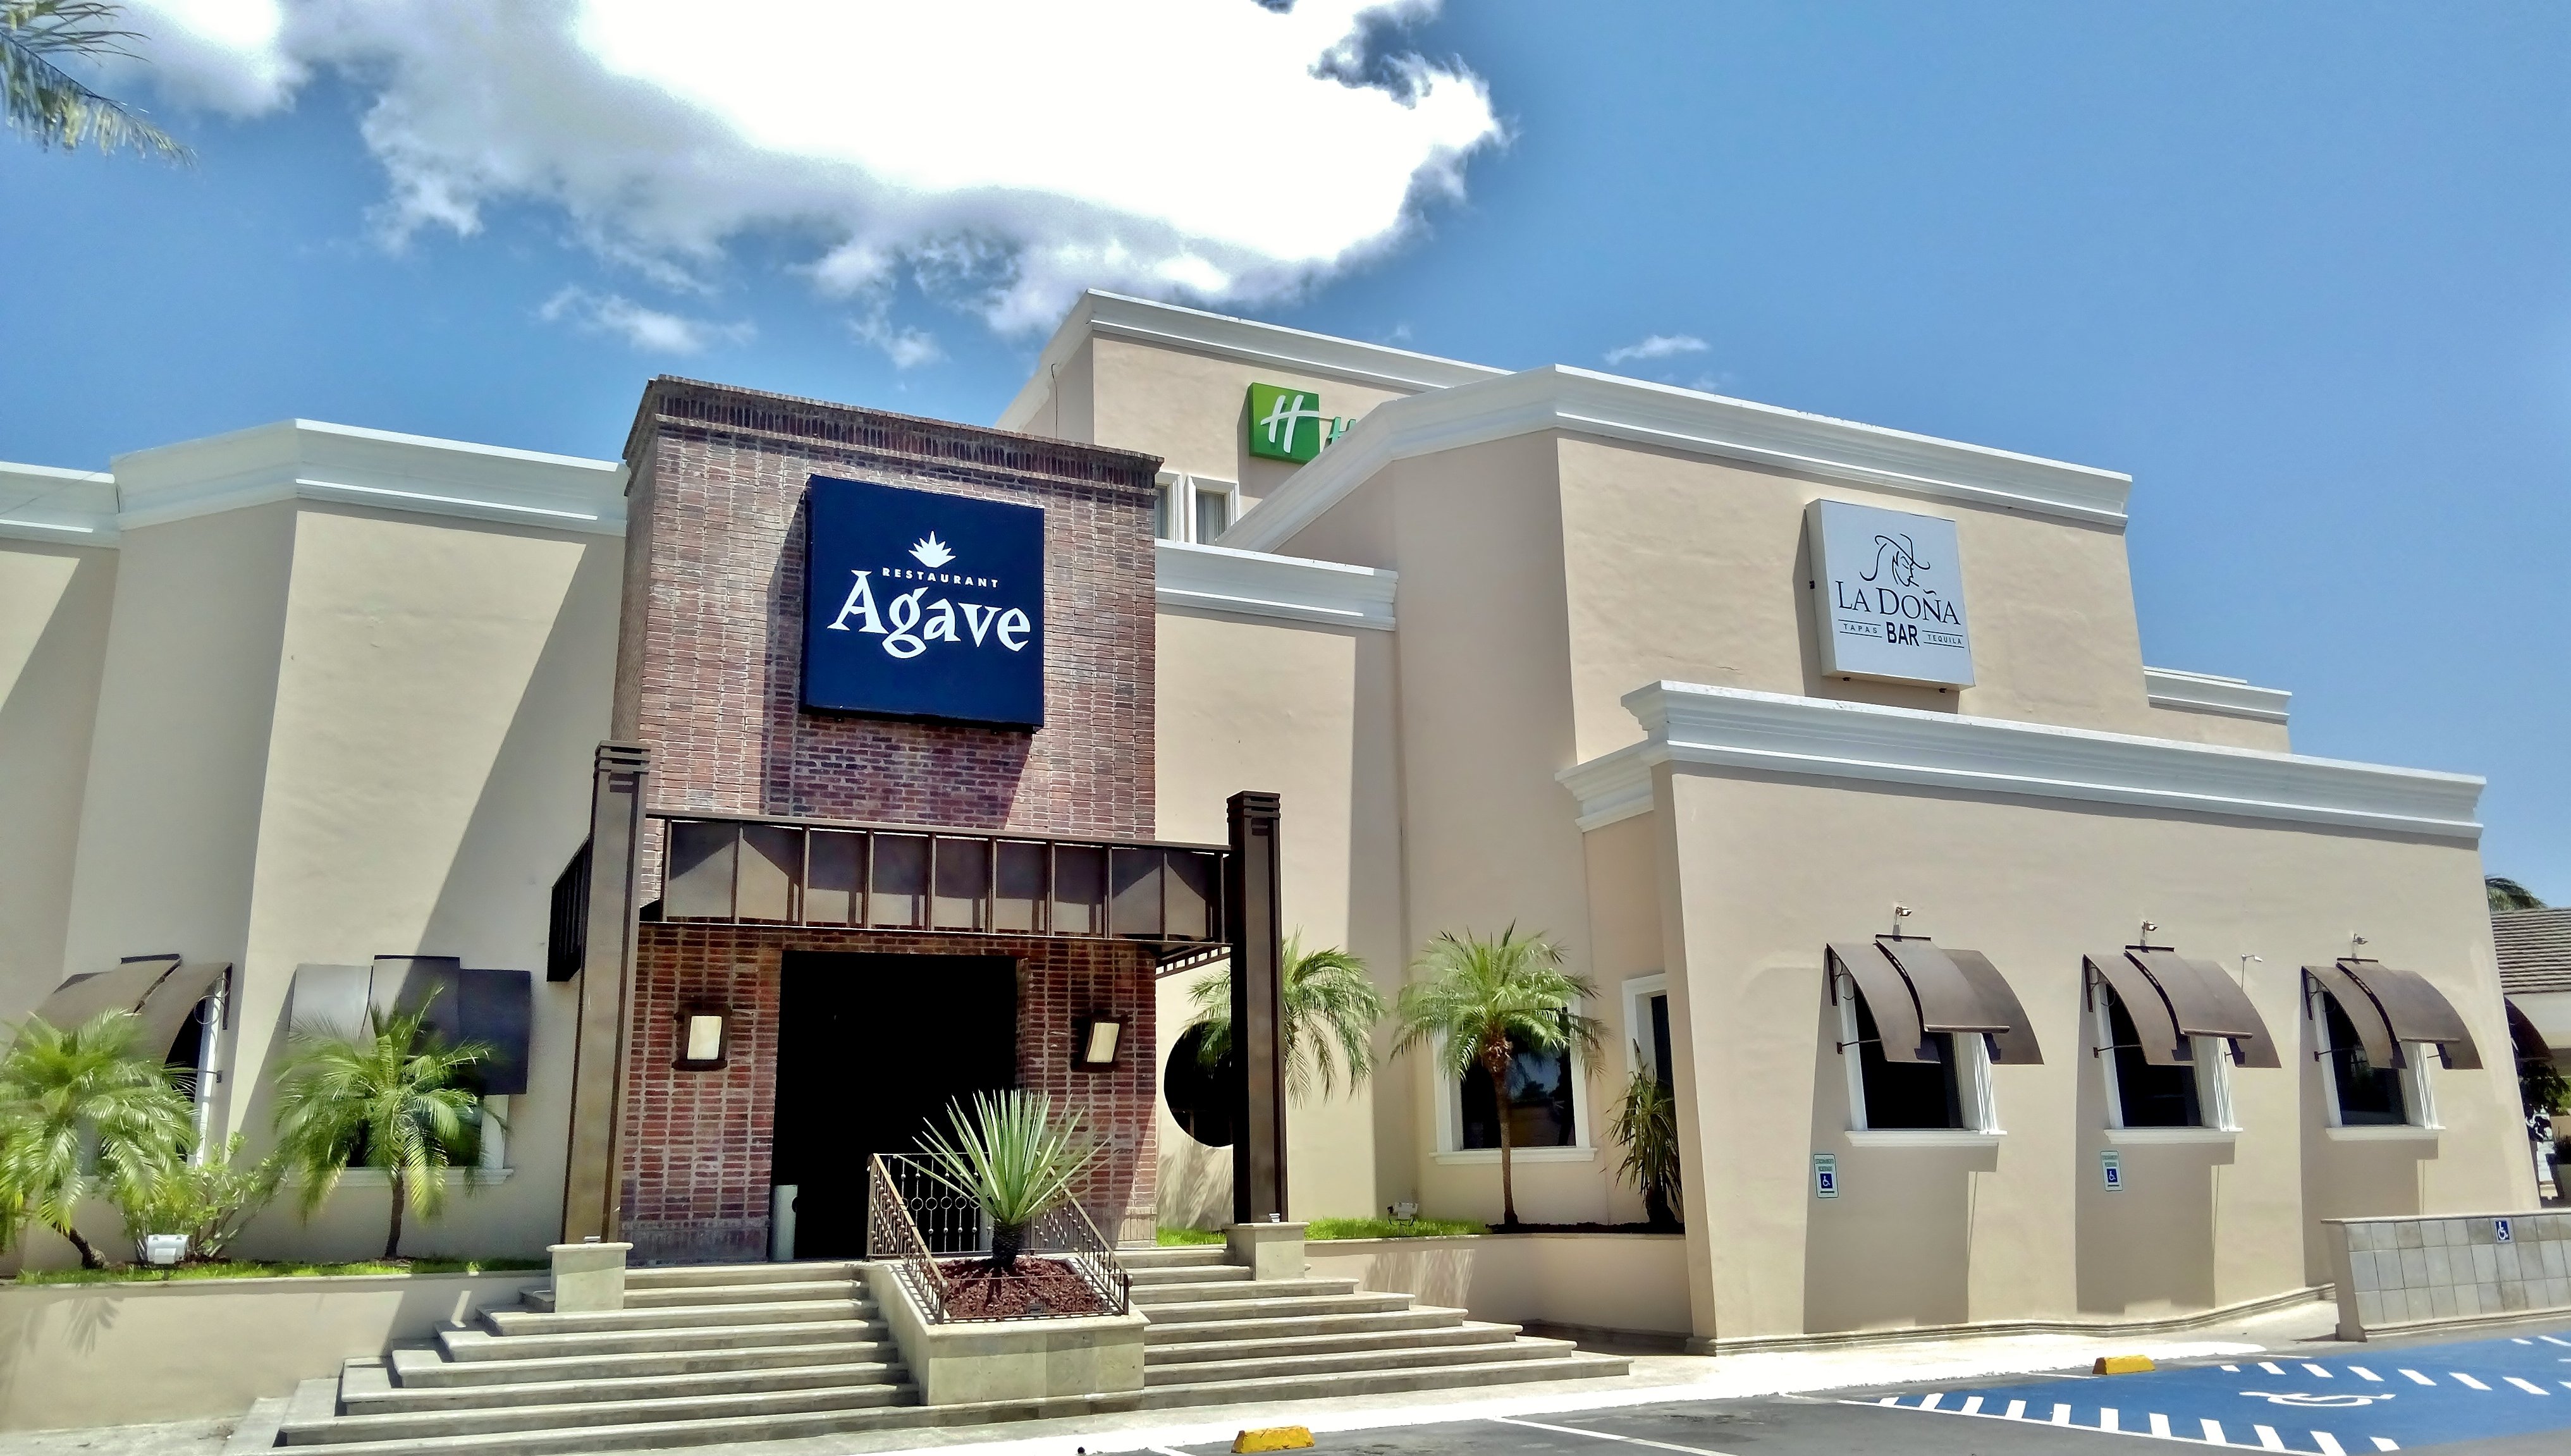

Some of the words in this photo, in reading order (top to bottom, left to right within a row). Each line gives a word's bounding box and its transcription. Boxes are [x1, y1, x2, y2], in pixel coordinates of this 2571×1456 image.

[882, 567, 998, 588] RESTAURANT
[826, 570, 1031, 659] Agave
[1835, 580, 1871, 613] LA
[1875, 587, 1961, 625] DOÑA
[1843, 623, 1878, 634] TAPAS
[1886, 621, 1920, 647] BAR
[1927, 634, 1963, 645] TEQUILA
